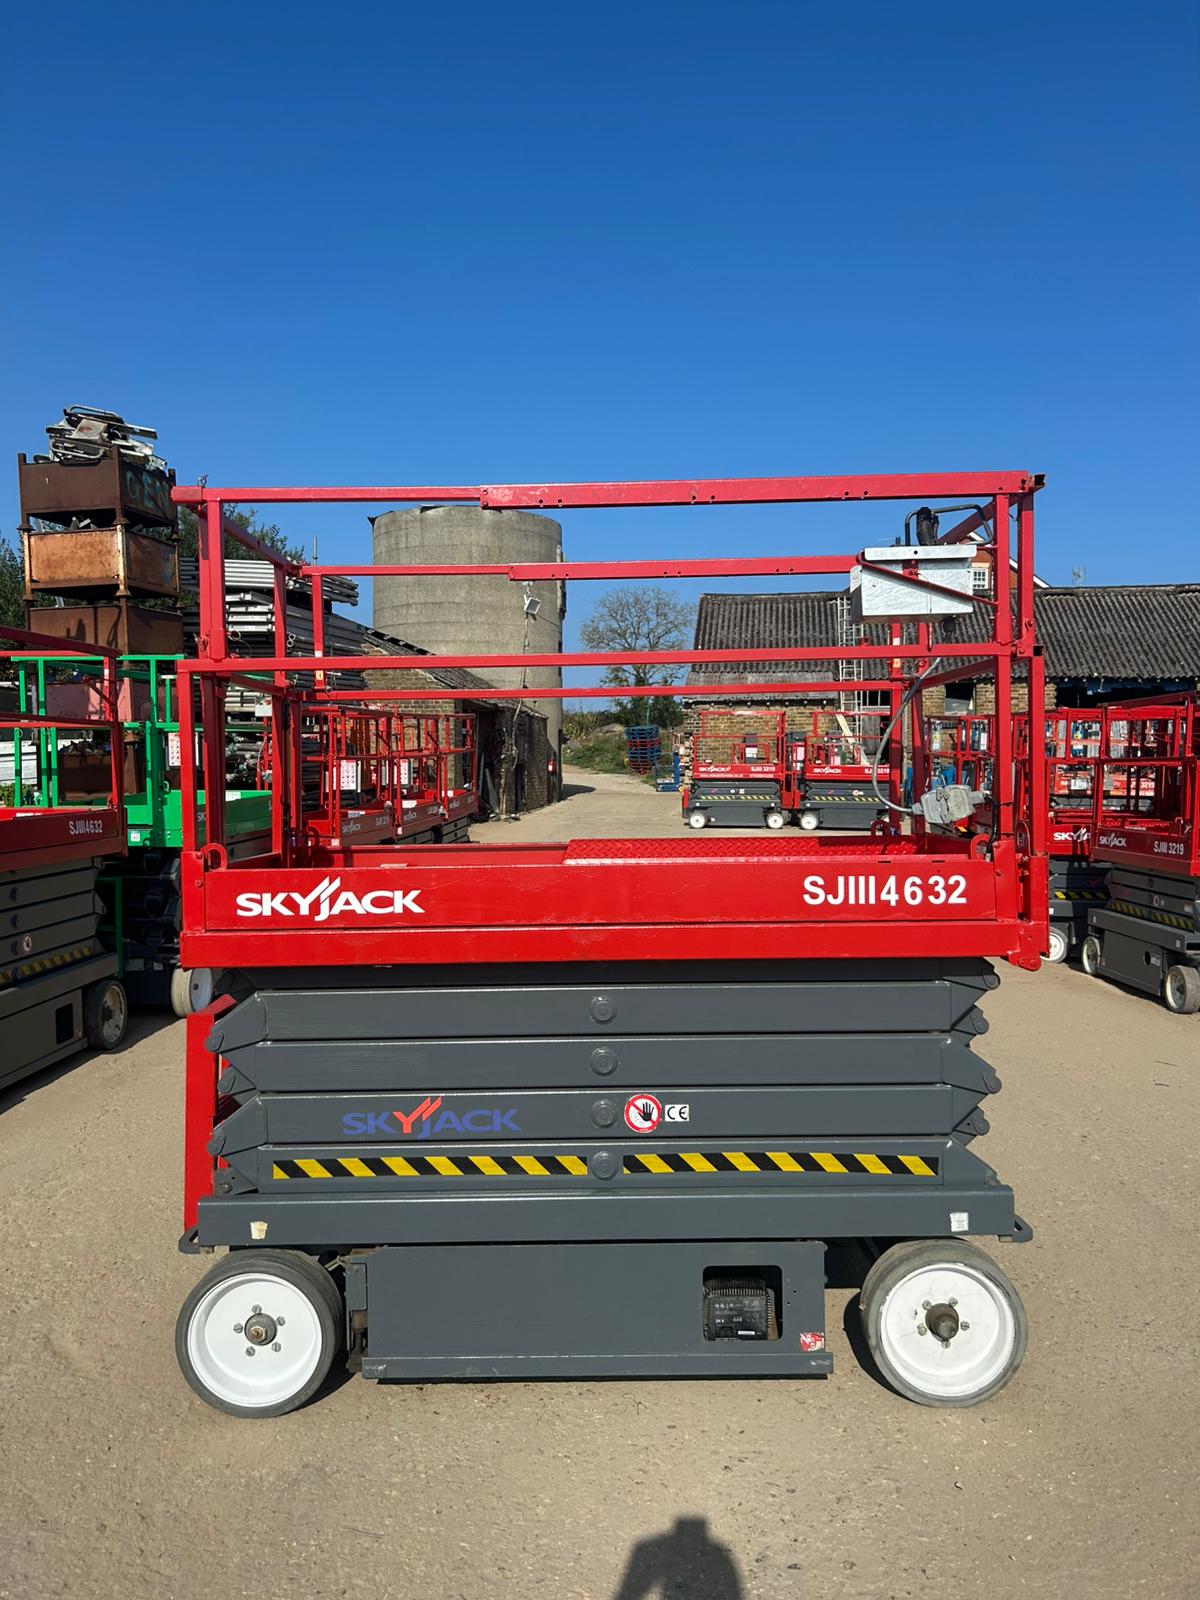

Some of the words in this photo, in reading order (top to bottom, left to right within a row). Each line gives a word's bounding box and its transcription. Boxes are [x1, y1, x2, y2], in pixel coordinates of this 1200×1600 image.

[1099, 832, 1127, 847] SKYJACK
[1168, 842, 1184, 855] 3219
[235, 876, 425, 922] SKYJACK
[341, 1096, 522, 1139] SKYJACK
